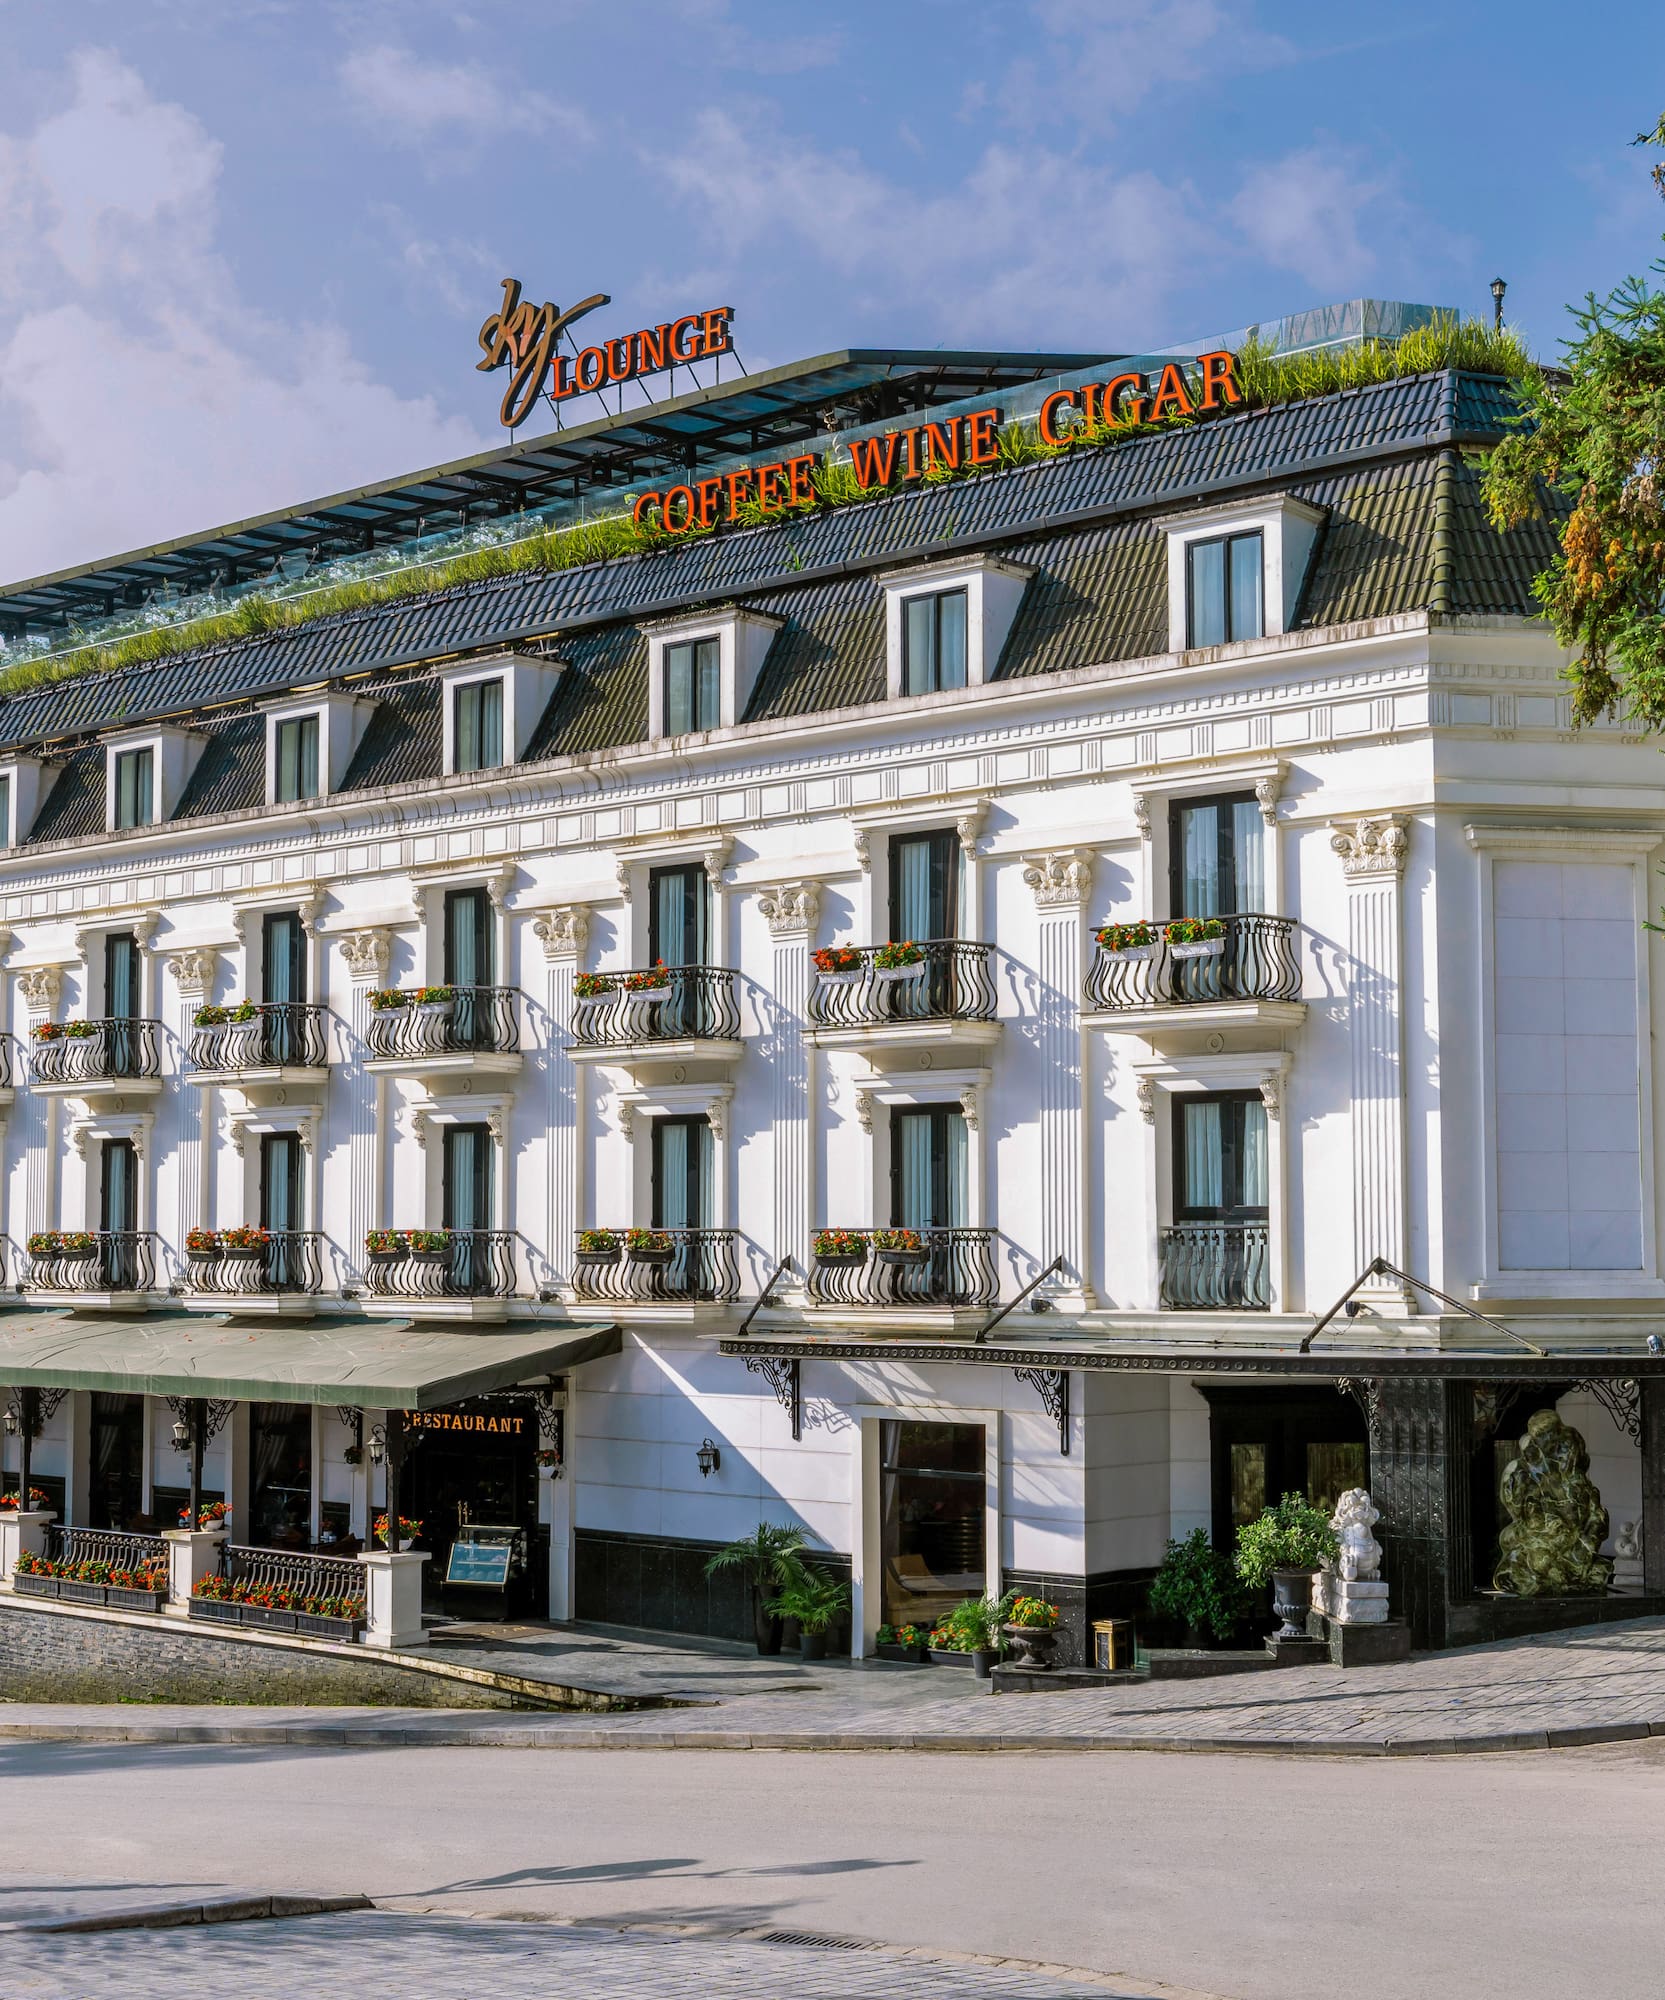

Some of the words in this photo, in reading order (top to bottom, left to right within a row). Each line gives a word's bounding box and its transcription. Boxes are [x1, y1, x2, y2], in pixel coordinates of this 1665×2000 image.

[550, 306, 735, 401] LOUNGE
[633, 453, 822, 539] COFFEE
[848, 407, 1004, 490] WINE
[1039, 350, 1241, 446] CIGAR
[412, 1412, 524, 1433] RESTAURANT
